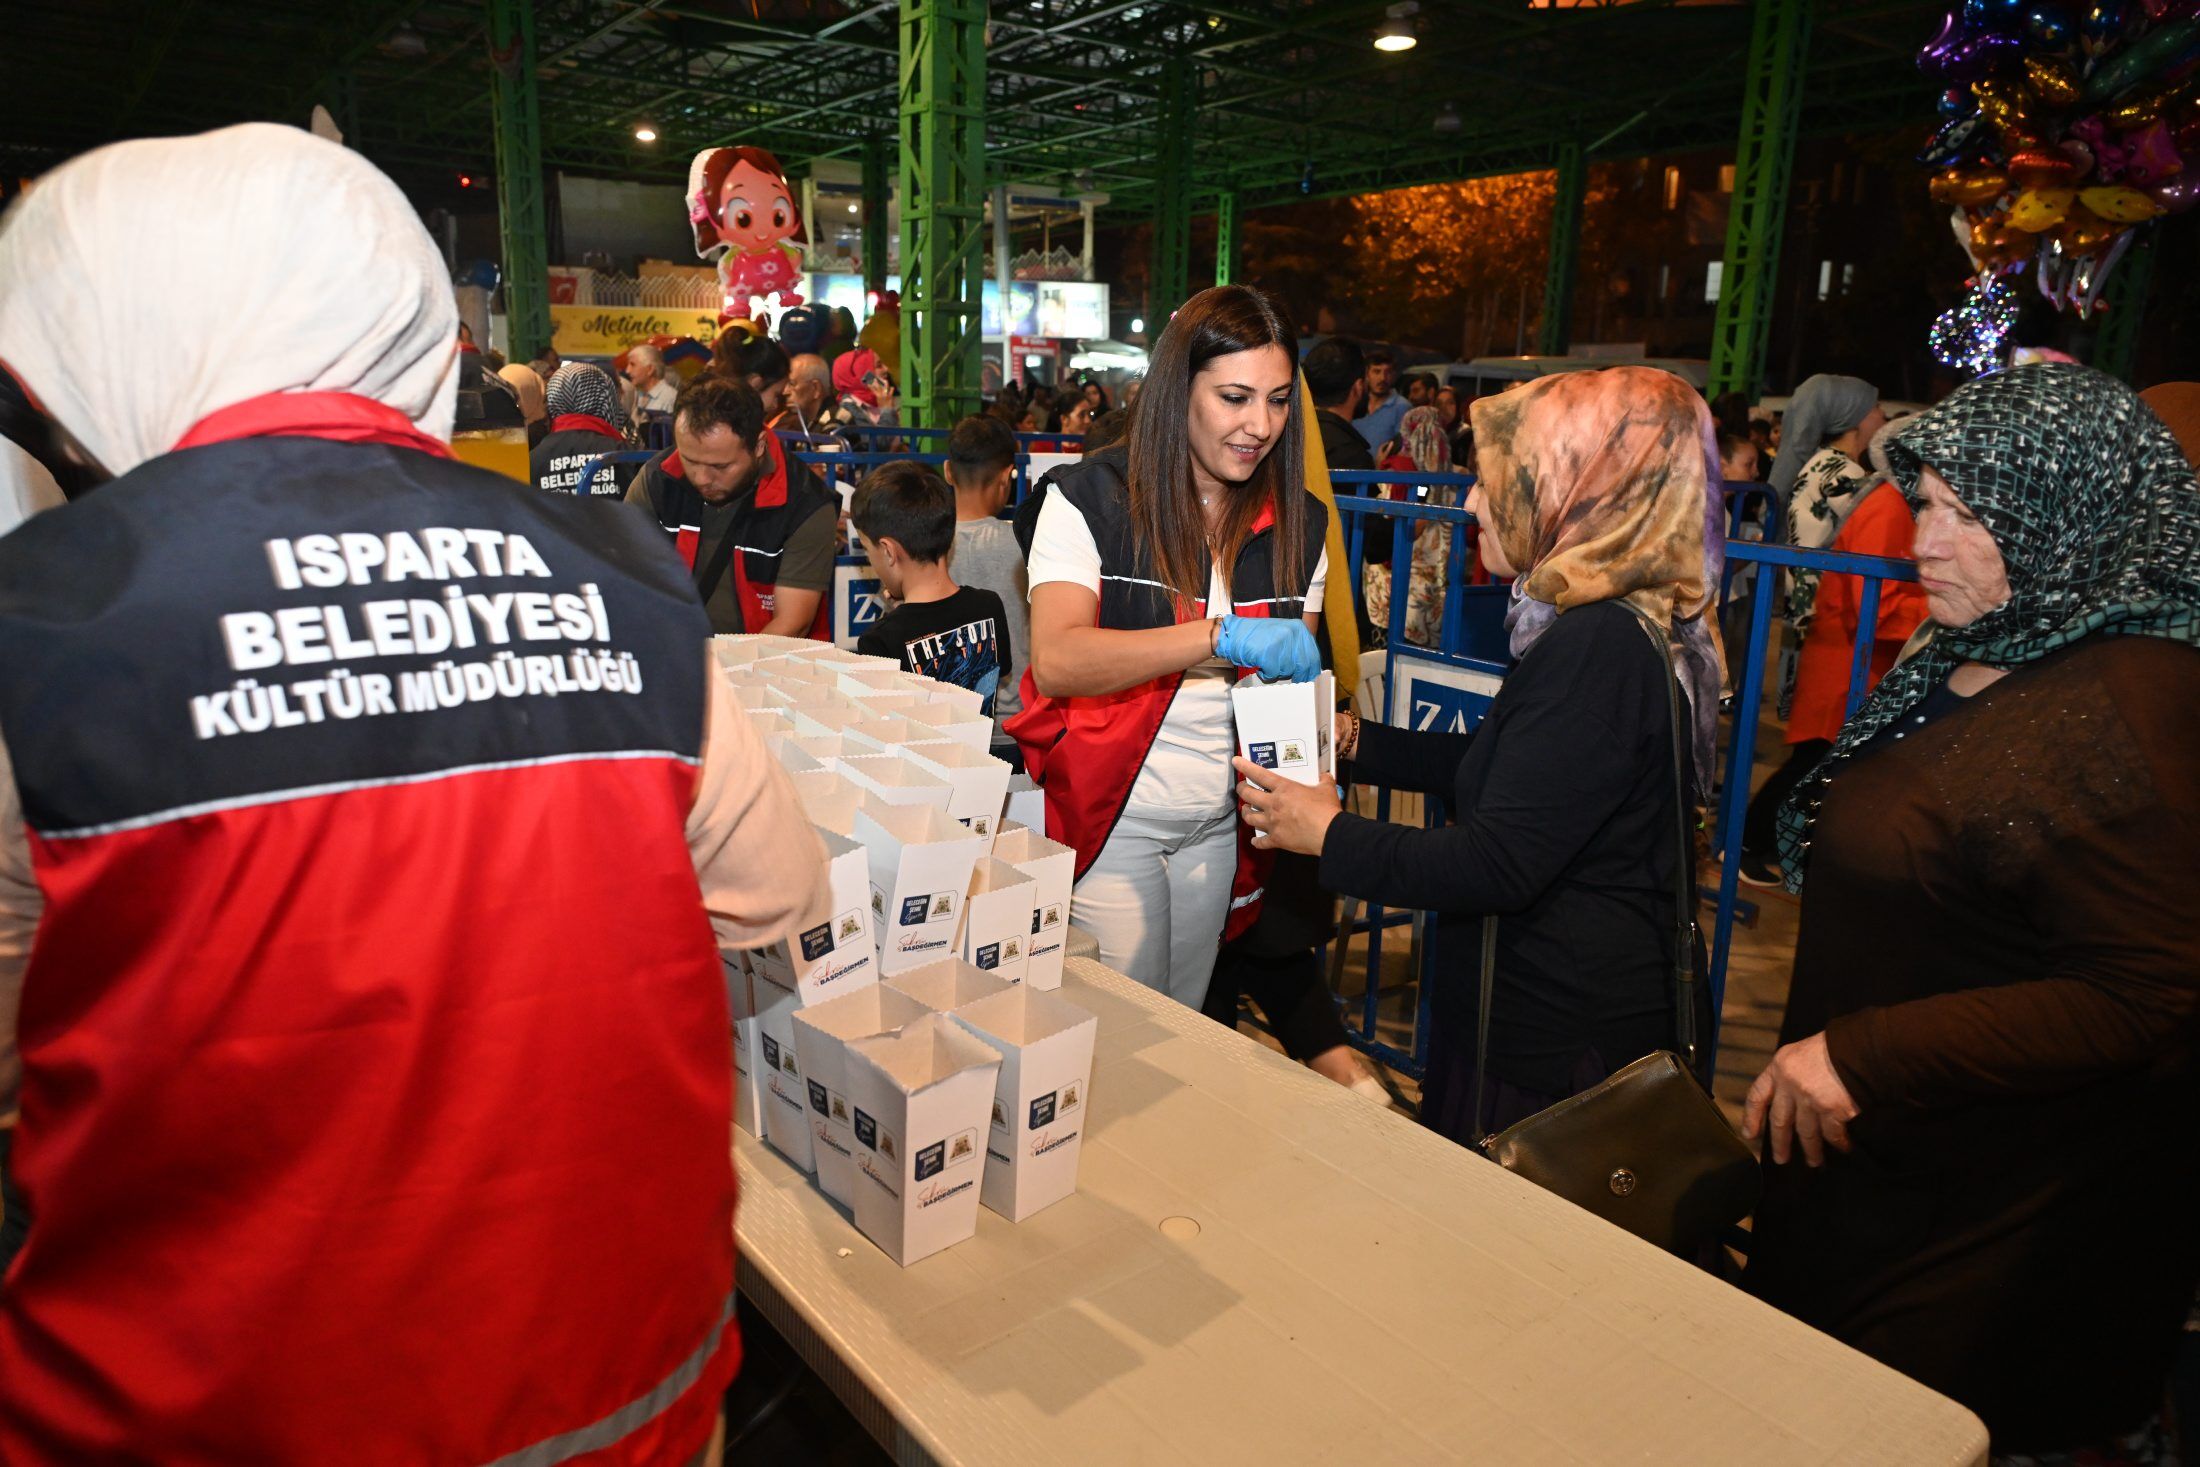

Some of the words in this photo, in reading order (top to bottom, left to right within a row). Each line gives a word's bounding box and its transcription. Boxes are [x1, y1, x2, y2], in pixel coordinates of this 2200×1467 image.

[582, 314, 671, 337] Metinler
[540, 465, 615, 489] BELEDESİ
[264, 527, 552, 590] ISPARTA
[220, 583, 611, 671] BELEDİYESİ
[906, 635, 945, 664] THE
[956, 619, 995, 647] SOUL
[915, 658, 939, 675] OF
[961, 639, 995, 659] THE
[190, 668, 397, 739] KÜLTÜR
[397, 648, 643, 713] MÜDÜRLÜĞÜ
[1416, 700, 1484, 732] ZA
